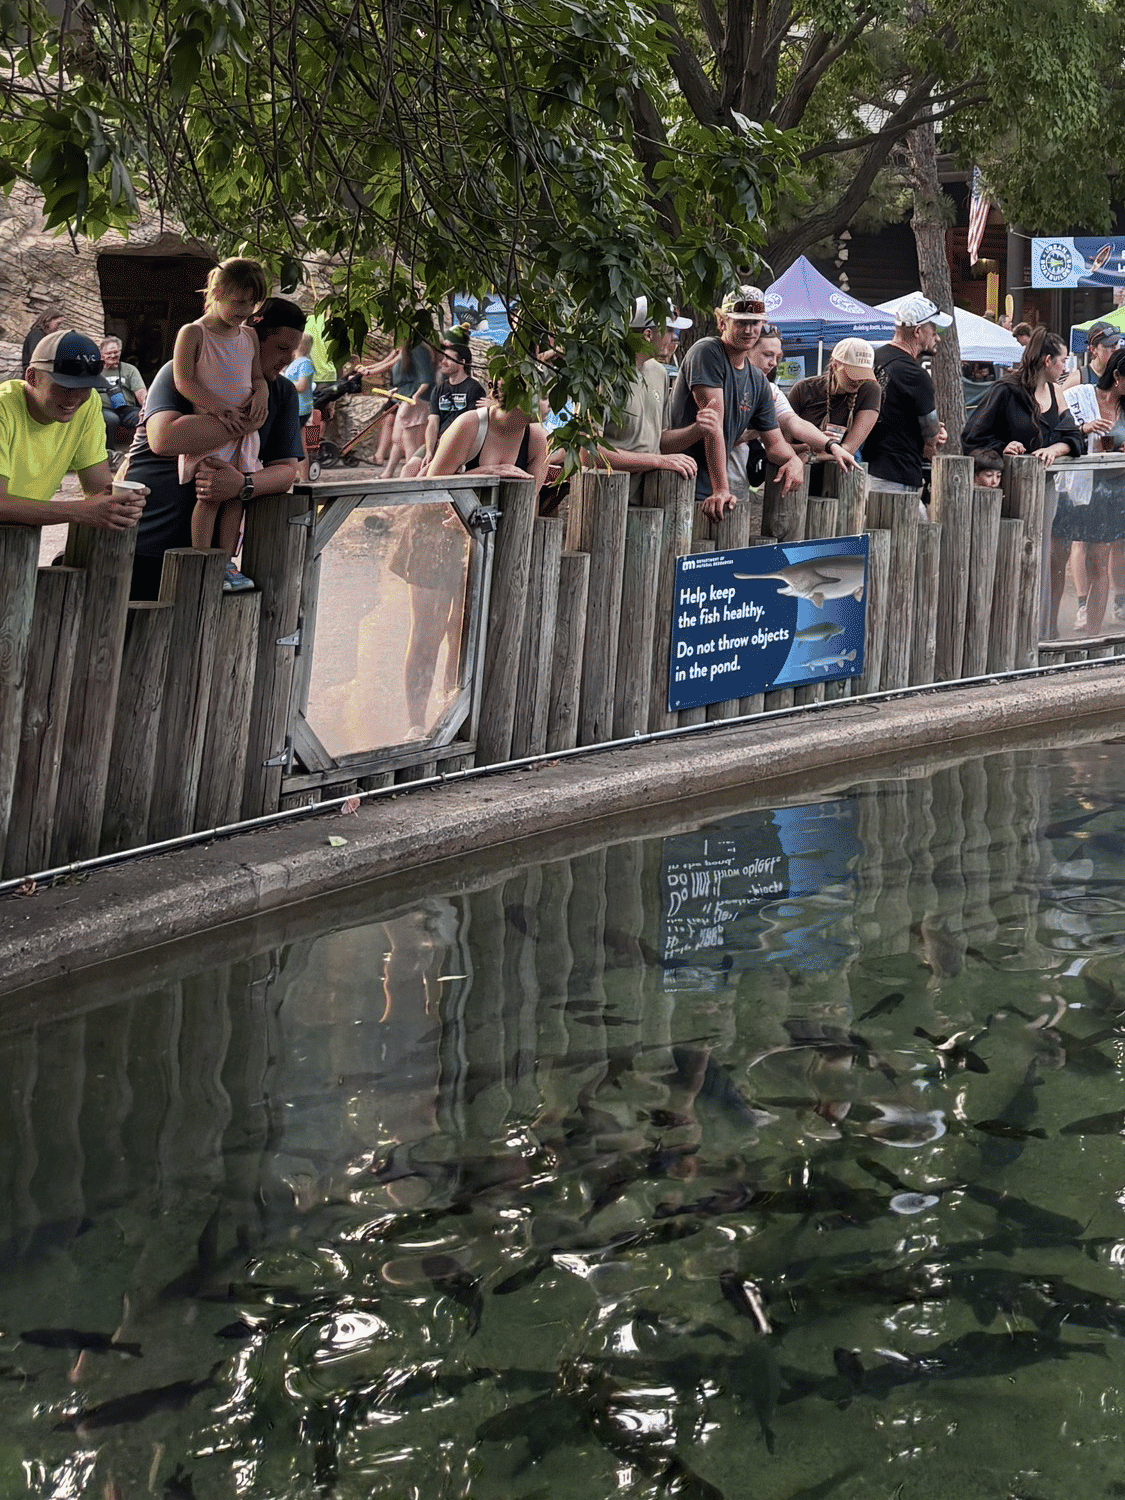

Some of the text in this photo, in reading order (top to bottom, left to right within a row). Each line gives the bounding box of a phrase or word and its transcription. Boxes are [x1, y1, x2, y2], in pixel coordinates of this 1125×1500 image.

[680, 584, 736, 608] Help keep
[678, 600, 766, 629] the fish healthy.
[676, 627, 790, 659] Do not throw objects
[674, 654, 741, 682] in the pond.
